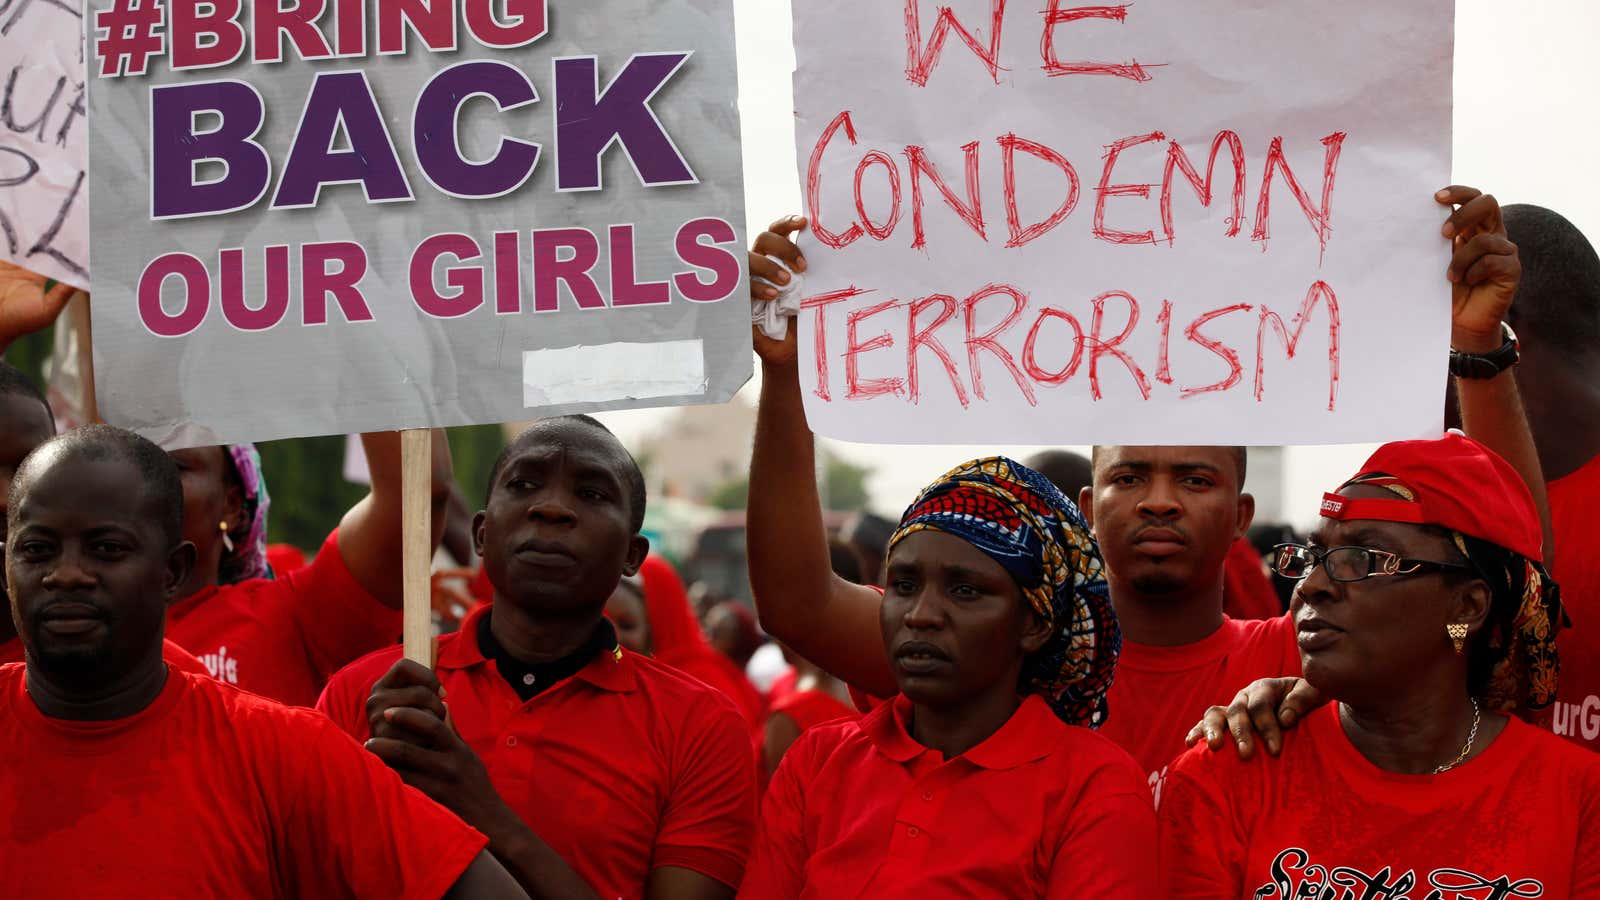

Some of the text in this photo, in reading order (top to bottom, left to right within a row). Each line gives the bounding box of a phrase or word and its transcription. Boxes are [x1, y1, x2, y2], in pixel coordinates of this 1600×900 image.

[95, 0, 548, 78] #BRING
[904, 0, 1167, 87] WE
[150, 51, 699, 220] BACK
[808, 111, 1347, 268] CONDEMN
[137, 217, 742, 338] OUR GIRLS
[801, 280, 1340, 412] TERRORISM
